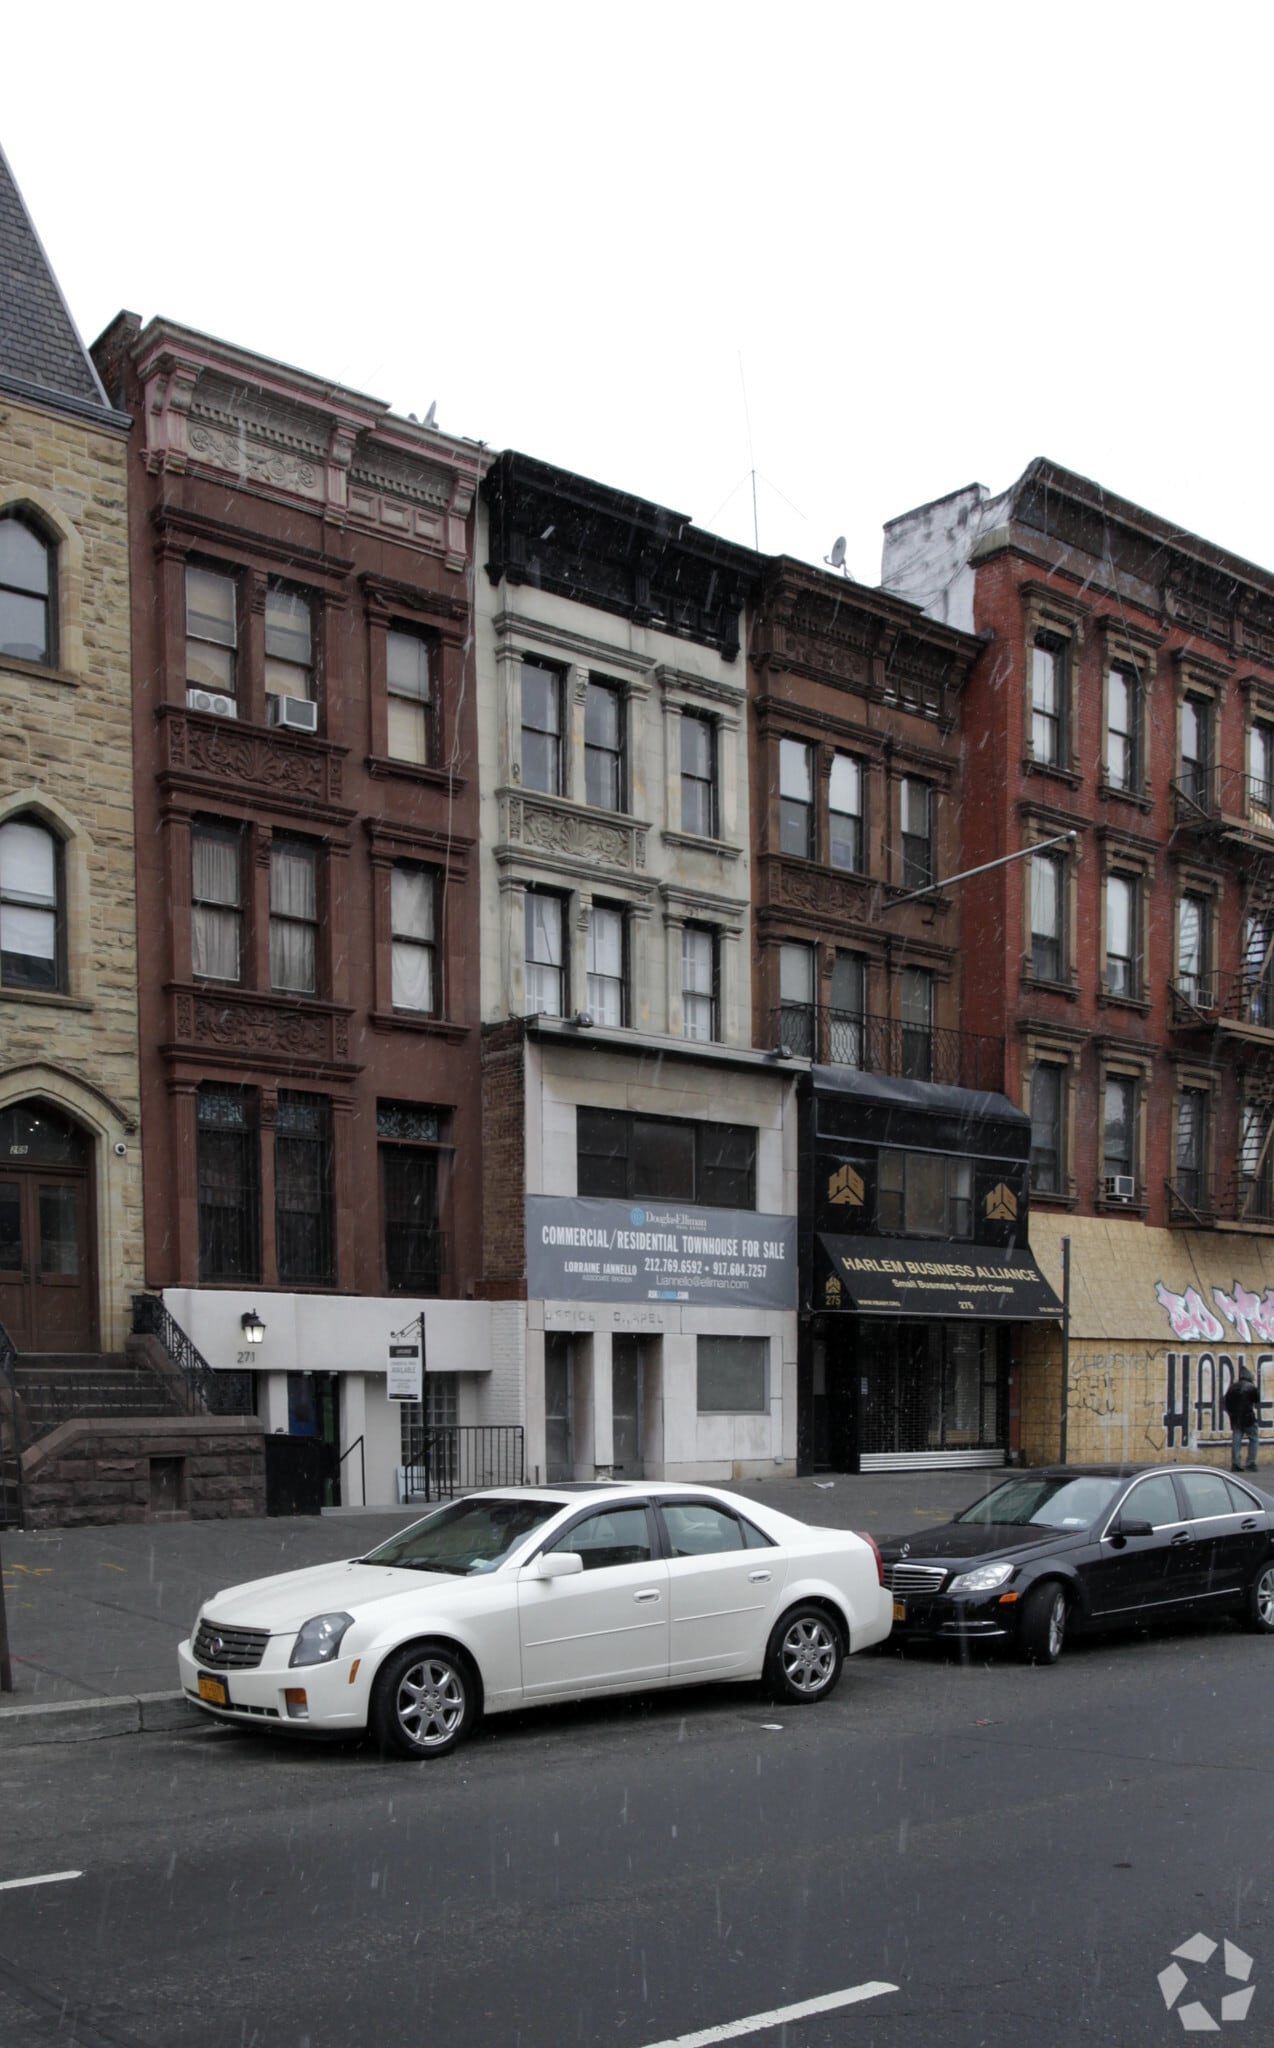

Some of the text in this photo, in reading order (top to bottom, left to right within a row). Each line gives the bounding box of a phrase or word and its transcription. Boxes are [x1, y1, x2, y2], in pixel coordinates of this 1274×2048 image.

[542, 1225, 785, 1259] COMMERCIAL/RESIDENTIAL TOWNHOUSE FOR SALE
[564, 1261, 638, 1276] LORRAINE IANNELLO
[644, 1257, 767, 1278] 212.769.6592 917.604.7257
[841, 1257, 1040, 1282] HARLEM BUSINESS ALLIANCE
[892, 1279, 1015, 1294] Small Business Support Center
[825, 1296, 841, 1306] 275
[958, 1301, 975, 1310] 275
[237, 1351, 255, 1363] 271
